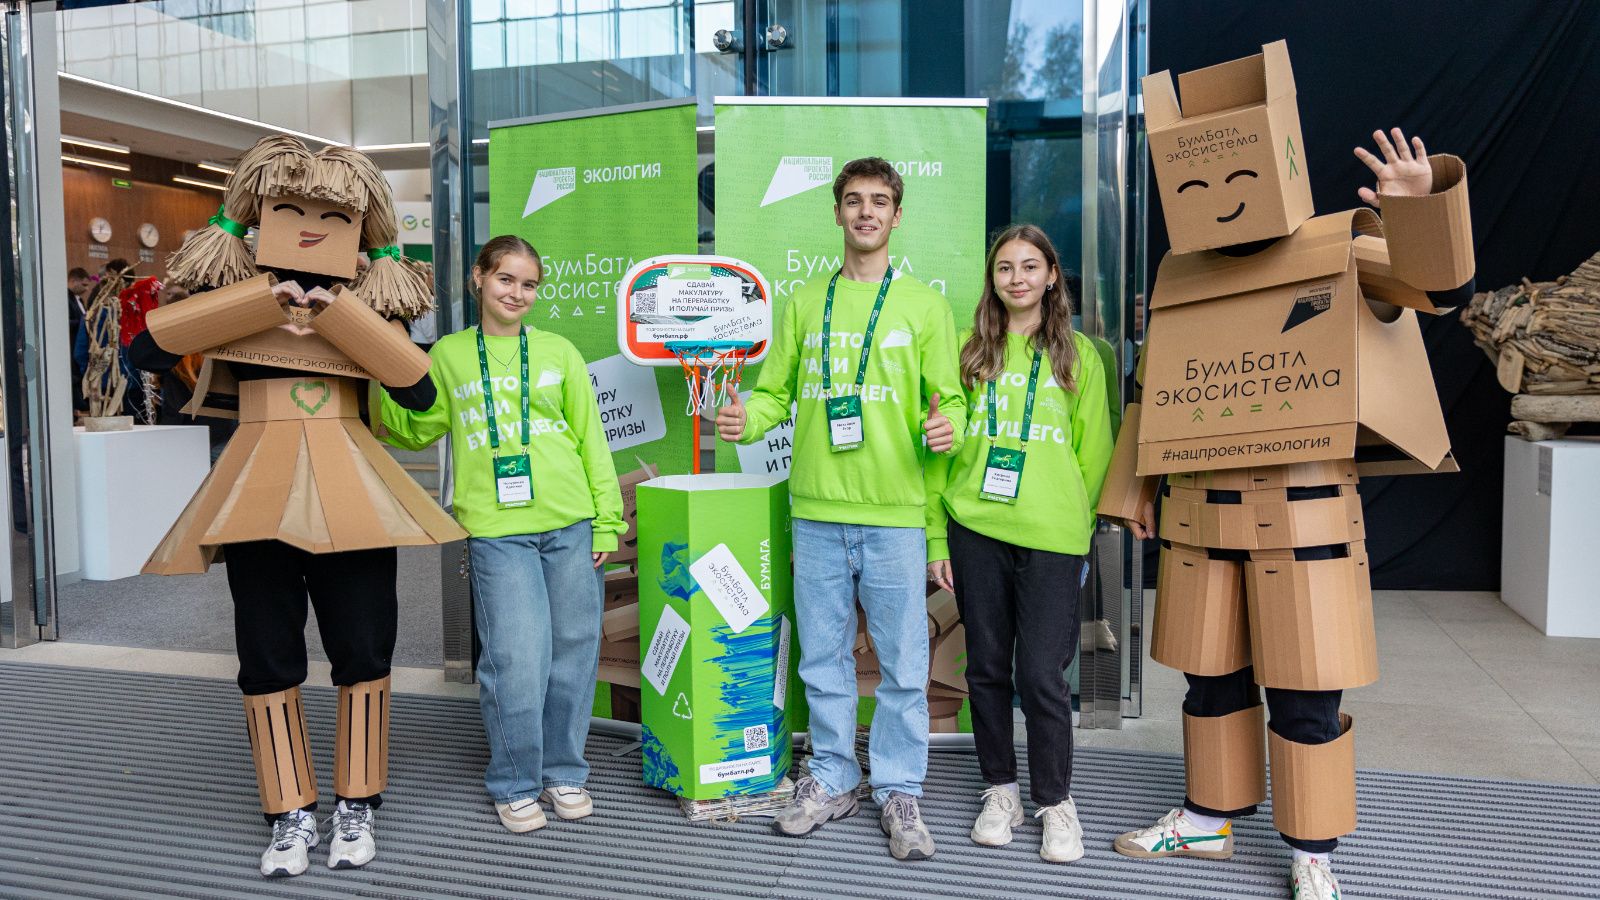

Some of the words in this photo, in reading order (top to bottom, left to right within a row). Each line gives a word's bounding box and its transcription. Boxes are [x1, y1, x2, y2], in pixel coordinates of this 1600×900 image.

[1166, 133, 1258, 163] экосистема
[1178, 127, 1240, 149] БумБатл
[583, 162, 662, 184] ЭКОЛОГИЯ
[787, 249, 913, 279] Бумтл
[686, 280, 715, 288] СДАВАЙ
[675, 304, 709, 312] ПОЛУЧАЙ
[652, 332, 689, 340] бумбатл.рф
[216, 343, 367, 374] #нацпроектэкология
[1185, 350, 1307, 384] БумБатл
[1155, 368, 1342, 407] экосистема
[767, 436, 792, 453] НА
[968, 420, 1066, 444] УУЩЕГО
[1162, 436, 1331, 462] #нацпроектэкология
[766, 459, 779, 473] И
[759, 538, 771, 591] БУМАГА
[708, 561, 750, 617] экосистема
[720, 564, 749, 604] БумБатл
[654, 627, 672, 668] МАКУЛАТУРУ
[660, 627, 679, 670] ПЕРЕРАБОТКУ
[662, 652, 677, 680] ПОЛУЧАЙ
[673, 630, 686, 653] ПРИЗЫ
[717, 767, 755, 778] бумбатл.рф
